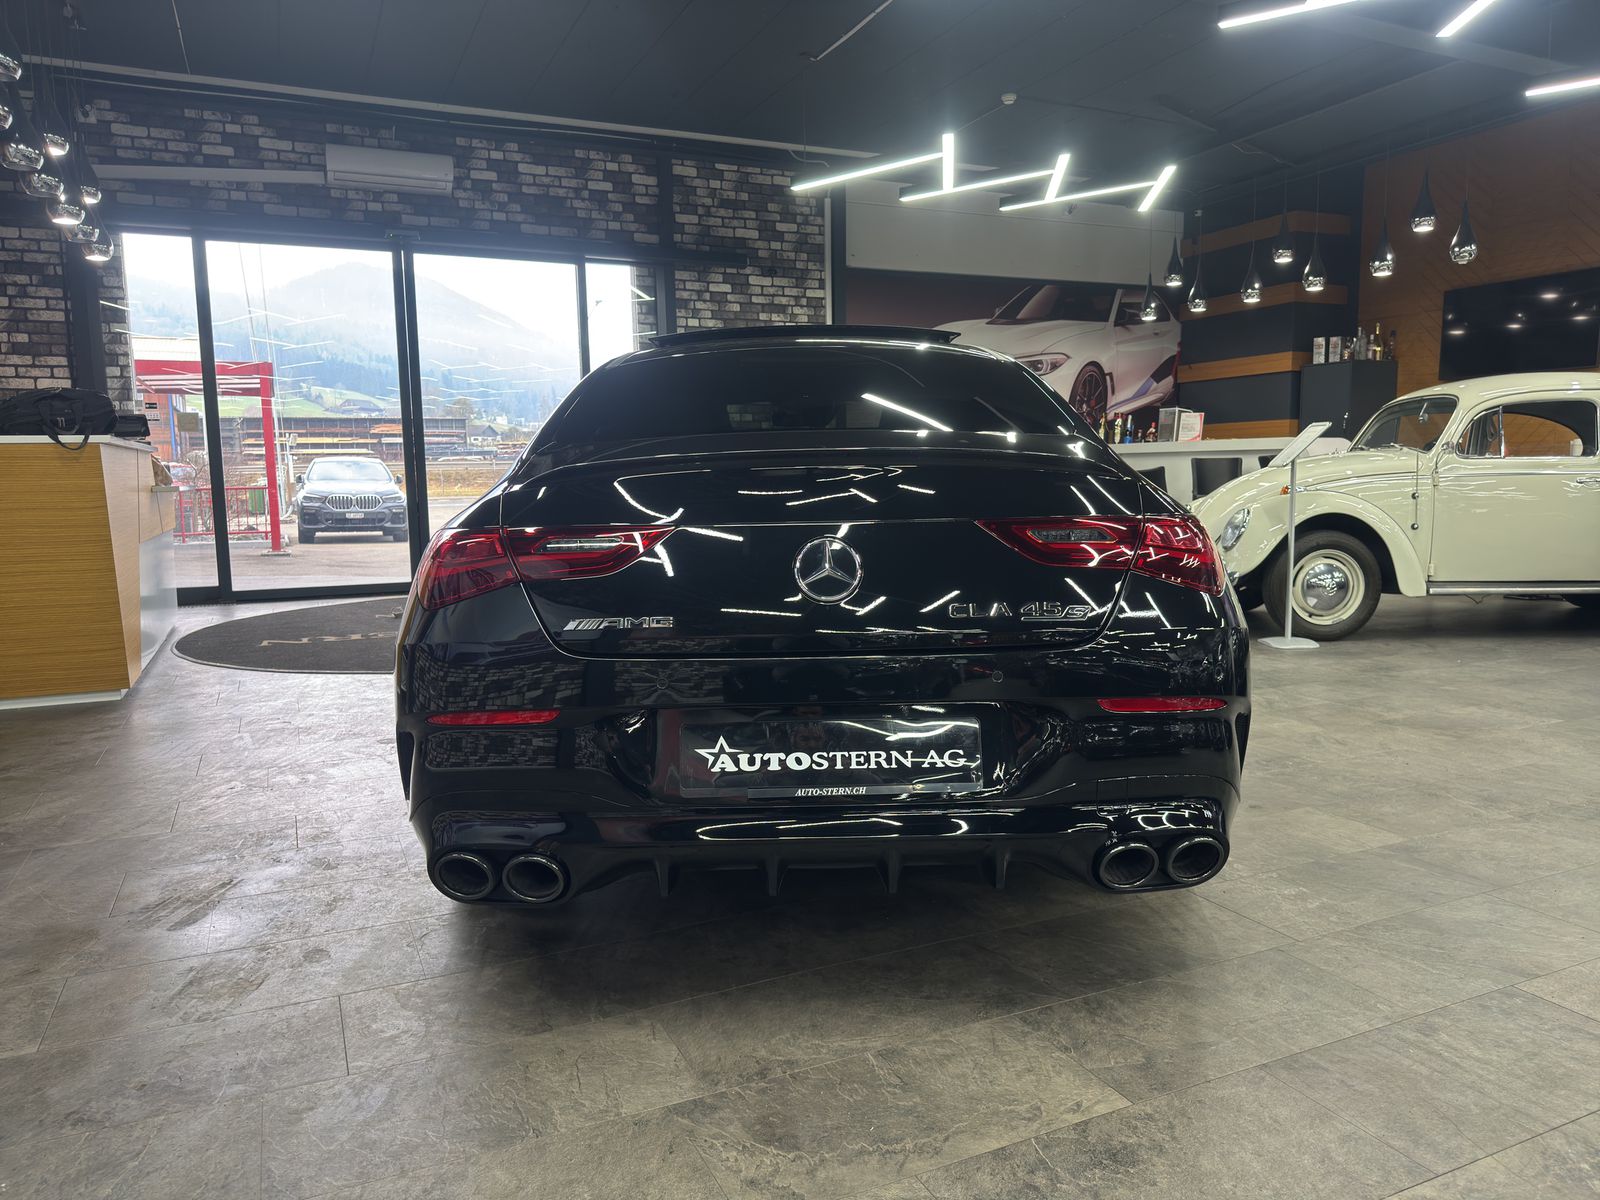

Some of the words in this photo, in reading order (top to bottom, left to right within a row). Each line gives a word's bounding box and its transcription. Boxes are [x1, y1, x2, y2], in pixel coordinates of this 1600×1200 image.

[949, 602, 1013, 618] CLA
[599, 616, 673, 629] AMG
[710, 750, 913, 772] AUTOSTERN
[921, 749, 968, 768] AG
[795, 786, 867, 797] AUTO-STERN.CH
